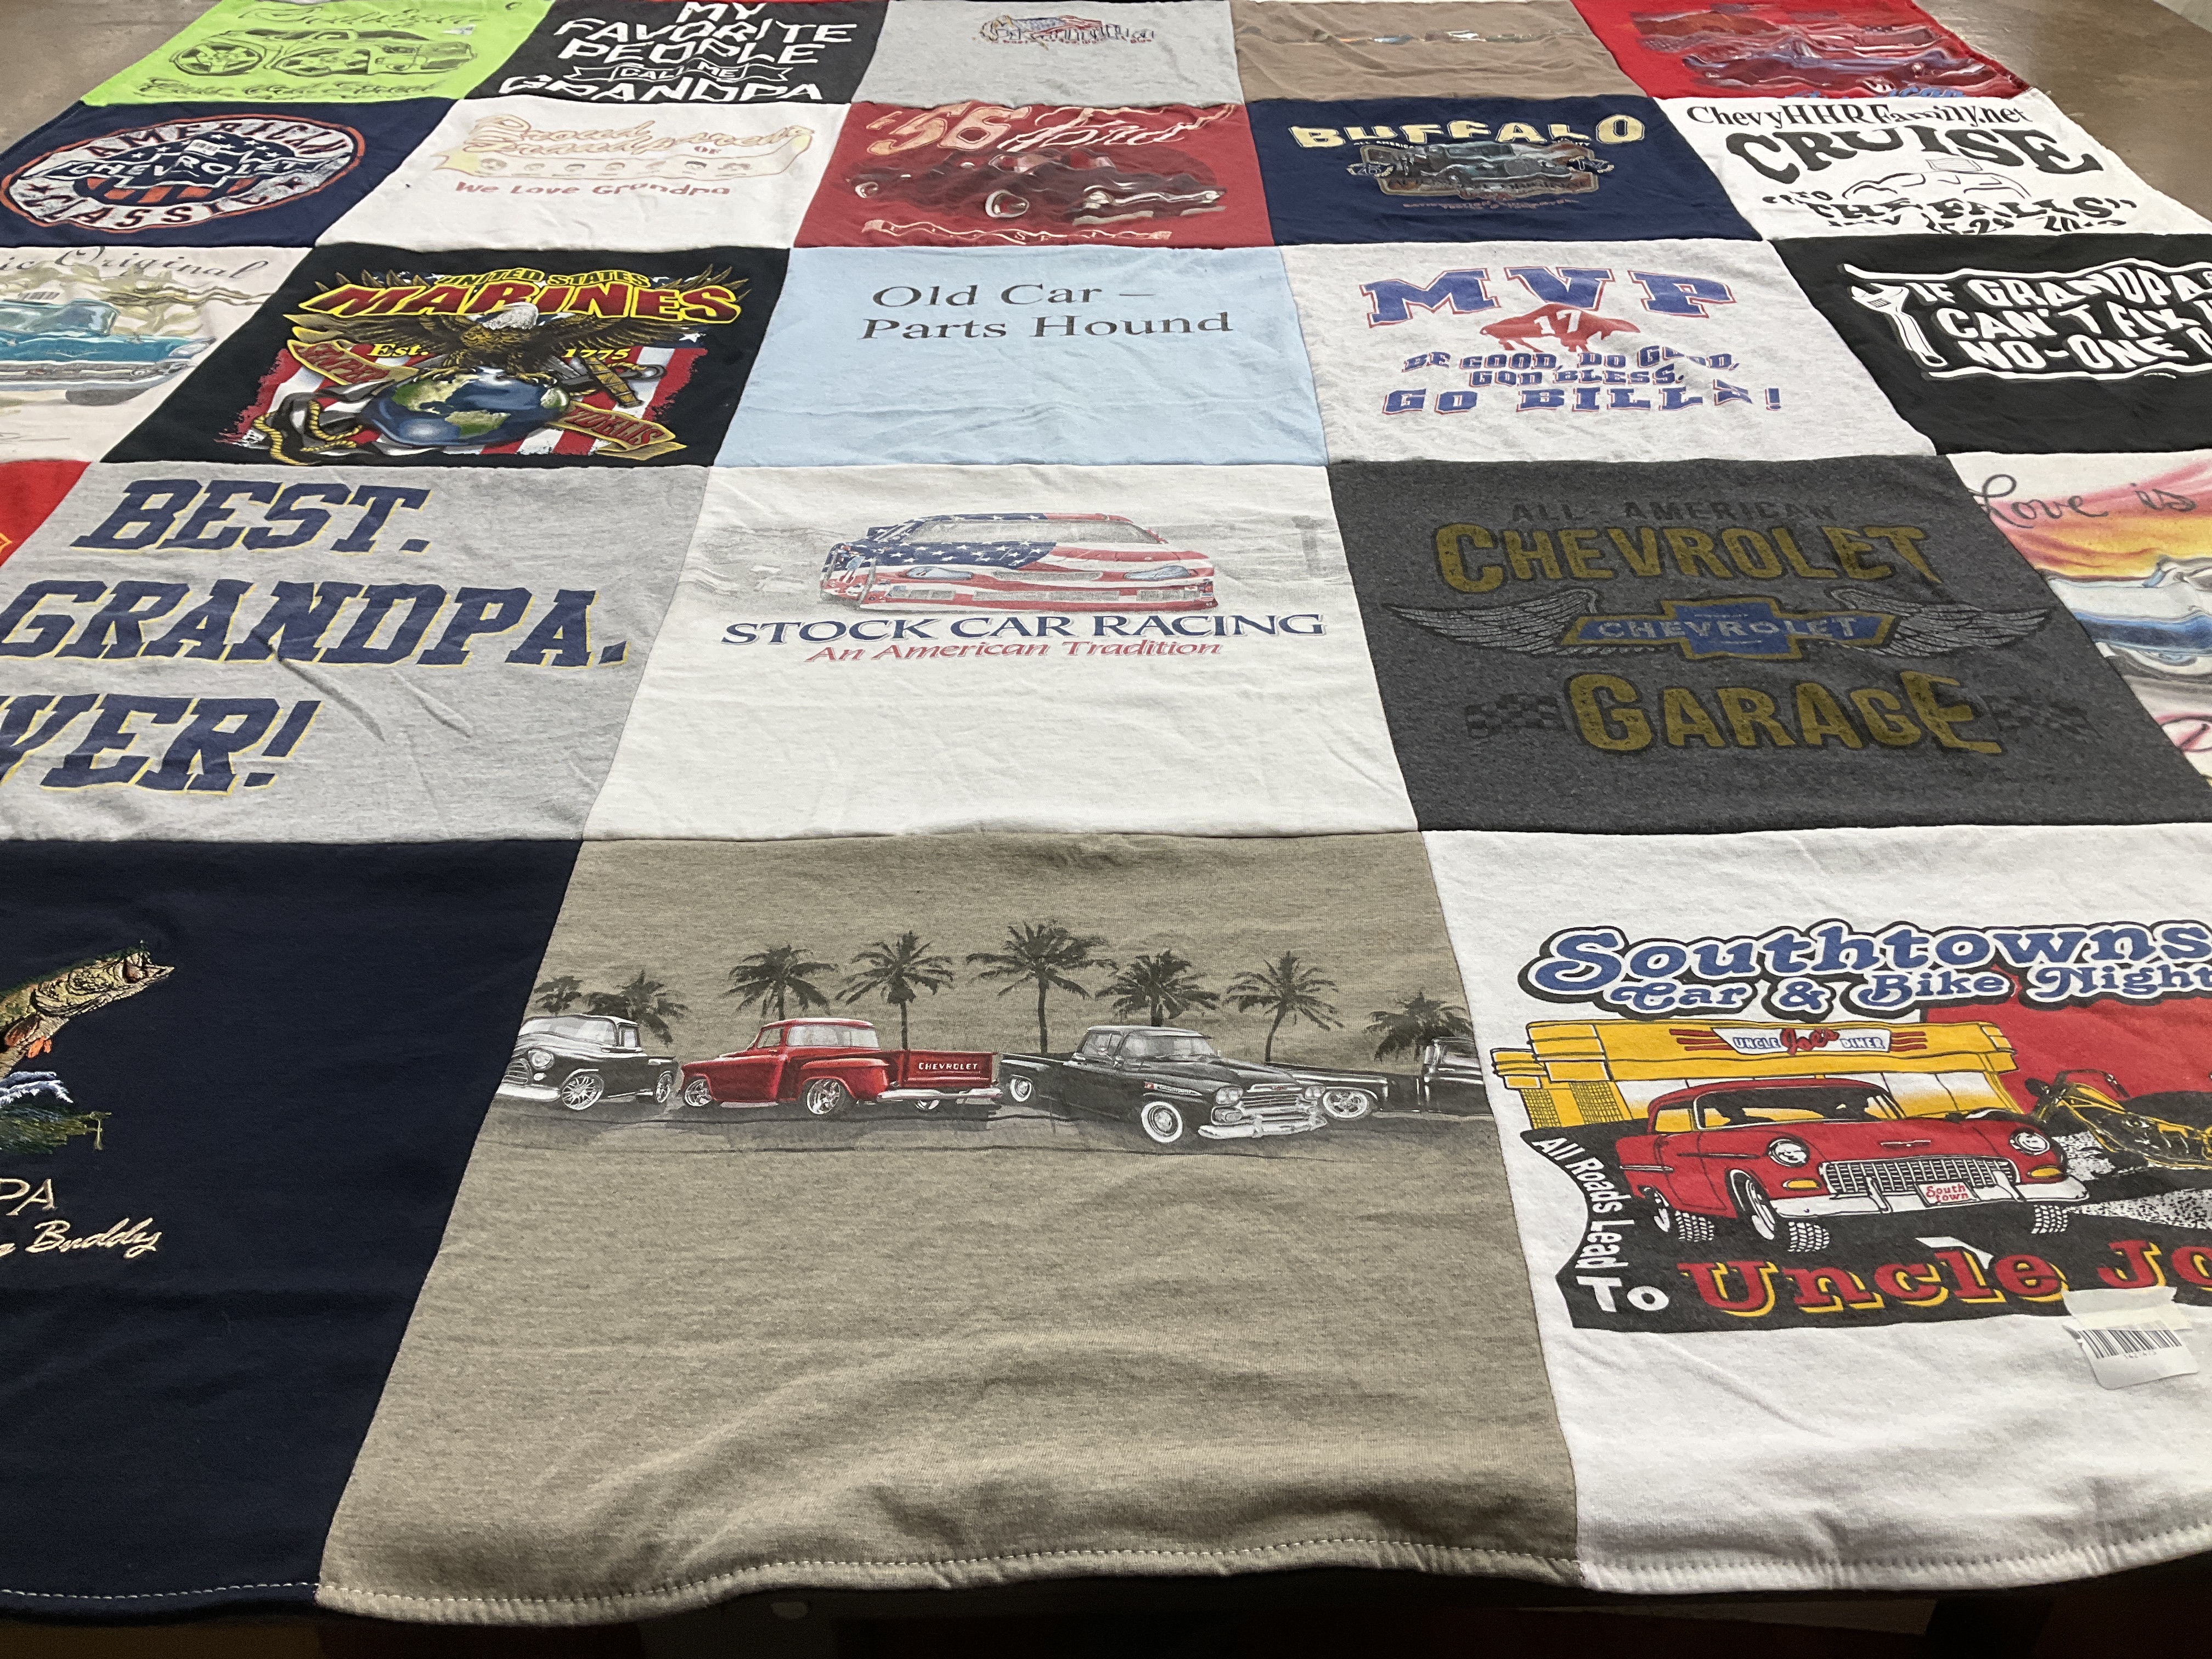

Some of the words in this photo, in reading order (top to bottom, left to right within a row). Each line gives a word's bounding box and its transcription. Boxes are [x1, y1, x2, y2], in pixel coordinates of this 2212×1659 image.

[676, 1, 767, 22] MY
[554, 18, 857, 43] FAVORITE
[558, 38, 825, 64] PEOPLE
[698, 61, 735, 77] ME
[499, 75, 823, 101] GRANDPA
[83, 116, 351, 157] AMERICAN
[469, 114, 656, 141] Proud
[1289, 114, 1644, 149] BUFFALO
[69, 154, 304, 177] CHEVROLET
[1725, 124, 2104, 184] CRUISE
[456, 182, 507, 194] We
[511, 182, 577, 195] Love
[592, 183, 730, 196] Grandpa
[23, 194, 270, 228] CLASSIC
[54, 246, 269, 278] Original
[433, 268, 546, 286] UNITED
[546, 269, 651, 288] STATES
[298, 280, 743, 325] MARINES
[872, 284, 978, 308] Old
[1001, 283, 1102, 304] Car
[1359, 267, 1736, 328] MVP
[1905, 282, 1956, 303] IF
[857, 318, 1007, 341] Parts
[1031, 311, 1234, 338] Hound
[1534, 309, 1582, 335] 17
[1936, 304, 2101, 339] CAN'T
[2107, 301, 2200, 337] FIX
[366, 343, 429, 357] Est.
[561, 348, 631, 360] 1775
[1402, 352, 1451, 372] BE
[1577, 352, 1626, 368] DO
[1958, 335, 2188, 370] NO-ONE
[1468, 370, 1543, 387] GOD
[1551, 363, 1684, 384] BLESS.
[1383, 389, 1478, 416] GO
[1623, 500, 1836, 522] AMERICAN
[1968, 473, 2109, 529] Love
[2131, 483, 2199, 512] is
[70, 478, 431, 554] BEST.
[1433, 522, 1943, 595] CHEVROLET
[0, 579, 628, 667] GRANDPA.
[720, 618, 939, 645] STOCK
[950, 614, 1078, 639] CAR
[1092, 613, 1327, 637] RACING
[1598, 616, 1858, 639] CHEVROLET
[804, 646, 865, 663] An
[871, 640, 1048, 661] American
[1062, 639, 1222, 657] Tradition
[1567, 670, 2002, 753] GARAGE
[1534, 924, 2212, 992] Southtowns
[1611, 982, 1747, 1011] Car
[1779, 980, 1826, 1010] &
[1858, 971, 2005, 1006] Bike
[1733, 1036, 1781, 1049] UNCLE
[1839, 1037, 1886, 1049] DINER
[918, 1062, 978, 1070] CHEVROLET
[1532, 1137, 1585, 1160] All
[1565, 1157, 1632, 1213] Roads
[1926, 1183, 1966, 1197] South
[1936, 1193, 1970, 1203] town
[25, 1217, 162, 1259] Buddy
[1575, 1220, 1635, 1268] Lead
[1677, 1251, 2069, 1317] Uncle
